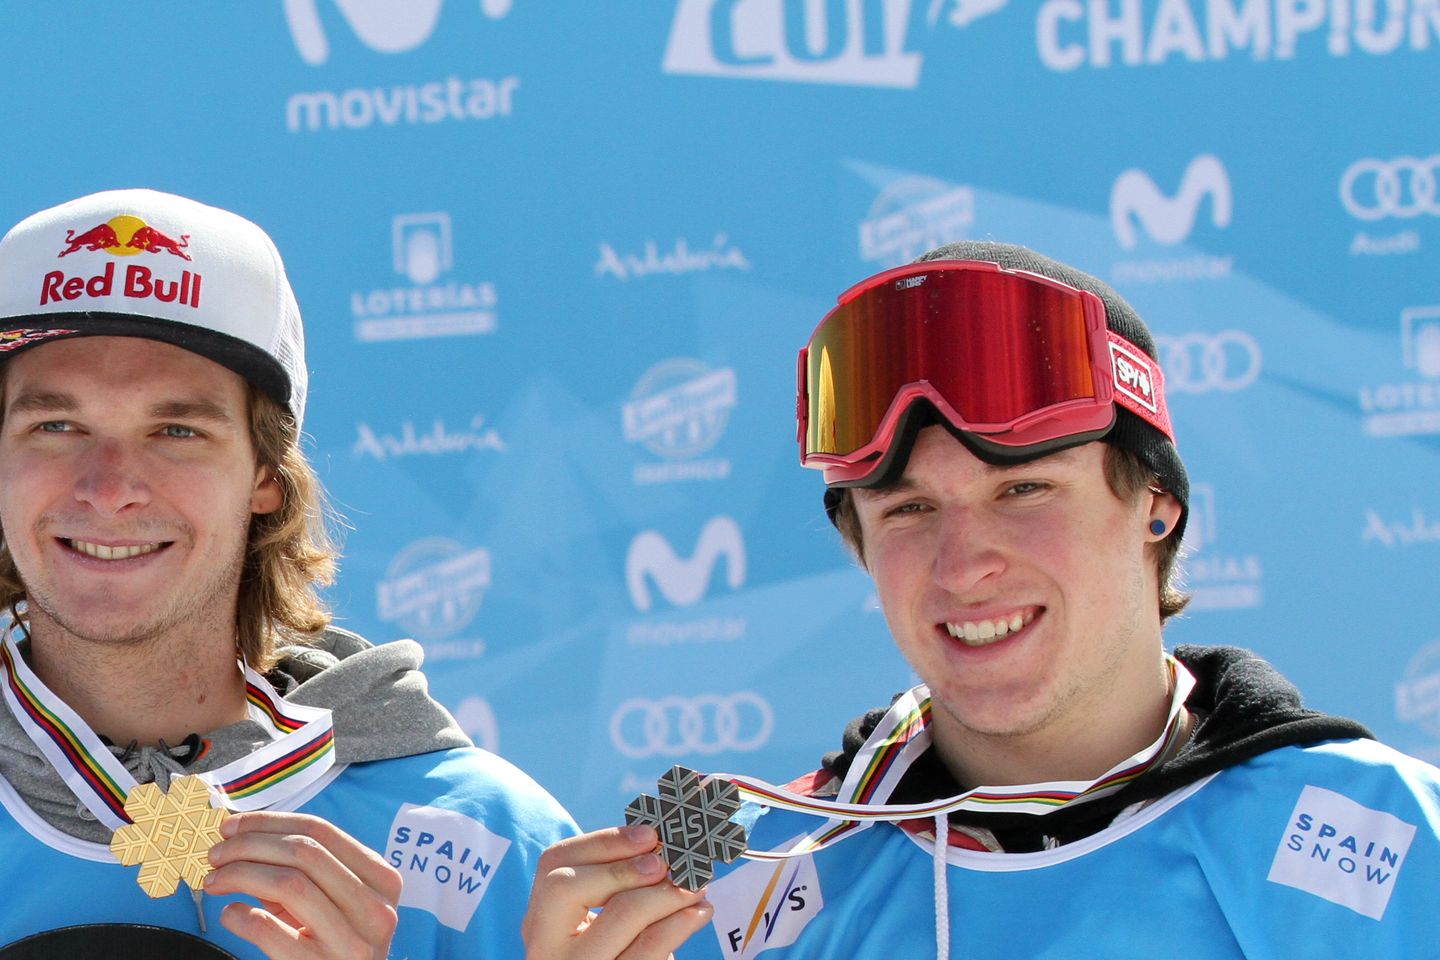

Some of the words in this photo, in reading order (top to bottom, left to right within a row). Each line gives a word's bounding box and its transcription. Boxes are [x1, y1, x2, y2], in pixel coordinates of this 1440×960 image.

[287, 76, 520, 133] movistar
[39, 261, 116, 306] Red
[123, 264, 202, 309] Bull
[1360, 384, 1440, 411] LOTE
[394, 826, 491, 878] SPAIN
[1287, 834, 1390, 885] SNOW
[1296, 813, 1398, 868] SPAIN
[389, 850, 481, 894] SNOW
